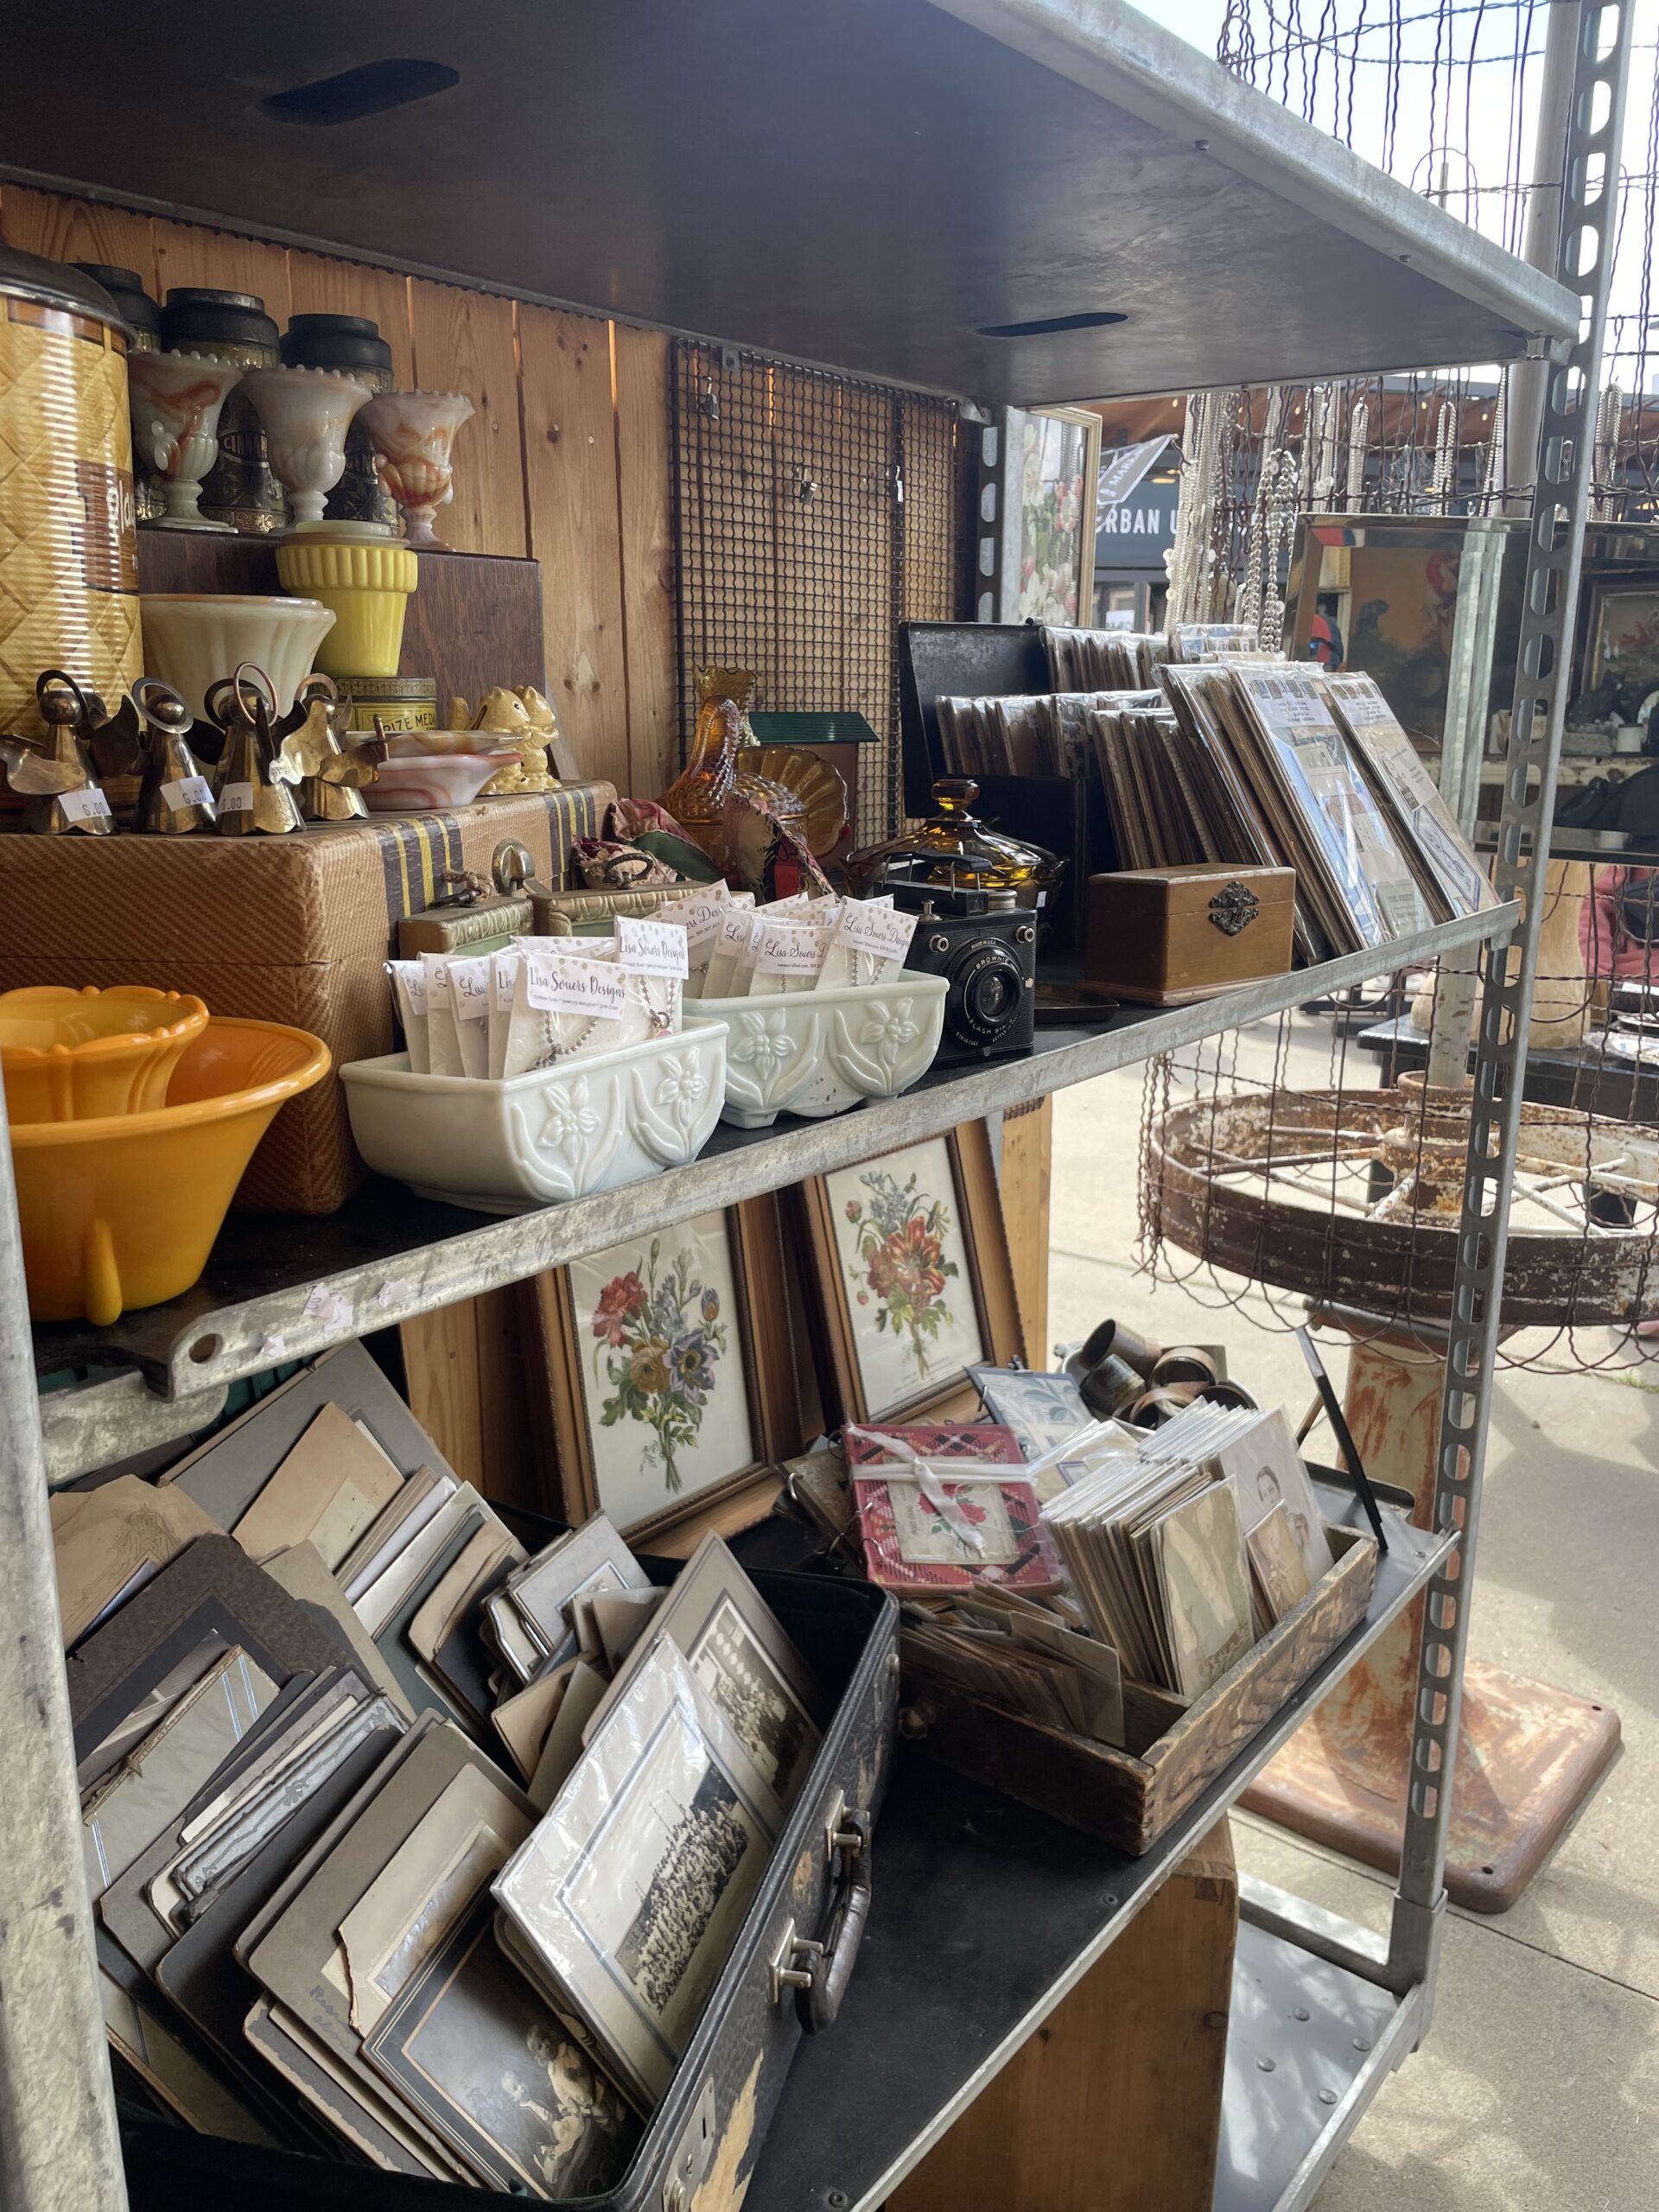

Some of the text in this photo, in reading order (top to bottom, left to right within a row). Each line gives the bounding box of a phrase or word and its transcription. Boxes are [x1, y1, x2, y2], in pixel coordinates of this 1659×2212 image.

[1104, 508, 1160, 534] RBAN
[82, 802, 105, 817] 6.00
[844, 912, 863, 934] Lisa
[765, 940, 787, 958] Lisa
[976, 956, 1010, 969] BROWNIE
[531, 967, 626, 1004] Lisa Souers Designs
[969, 1018, 992, 1034] FLASH
